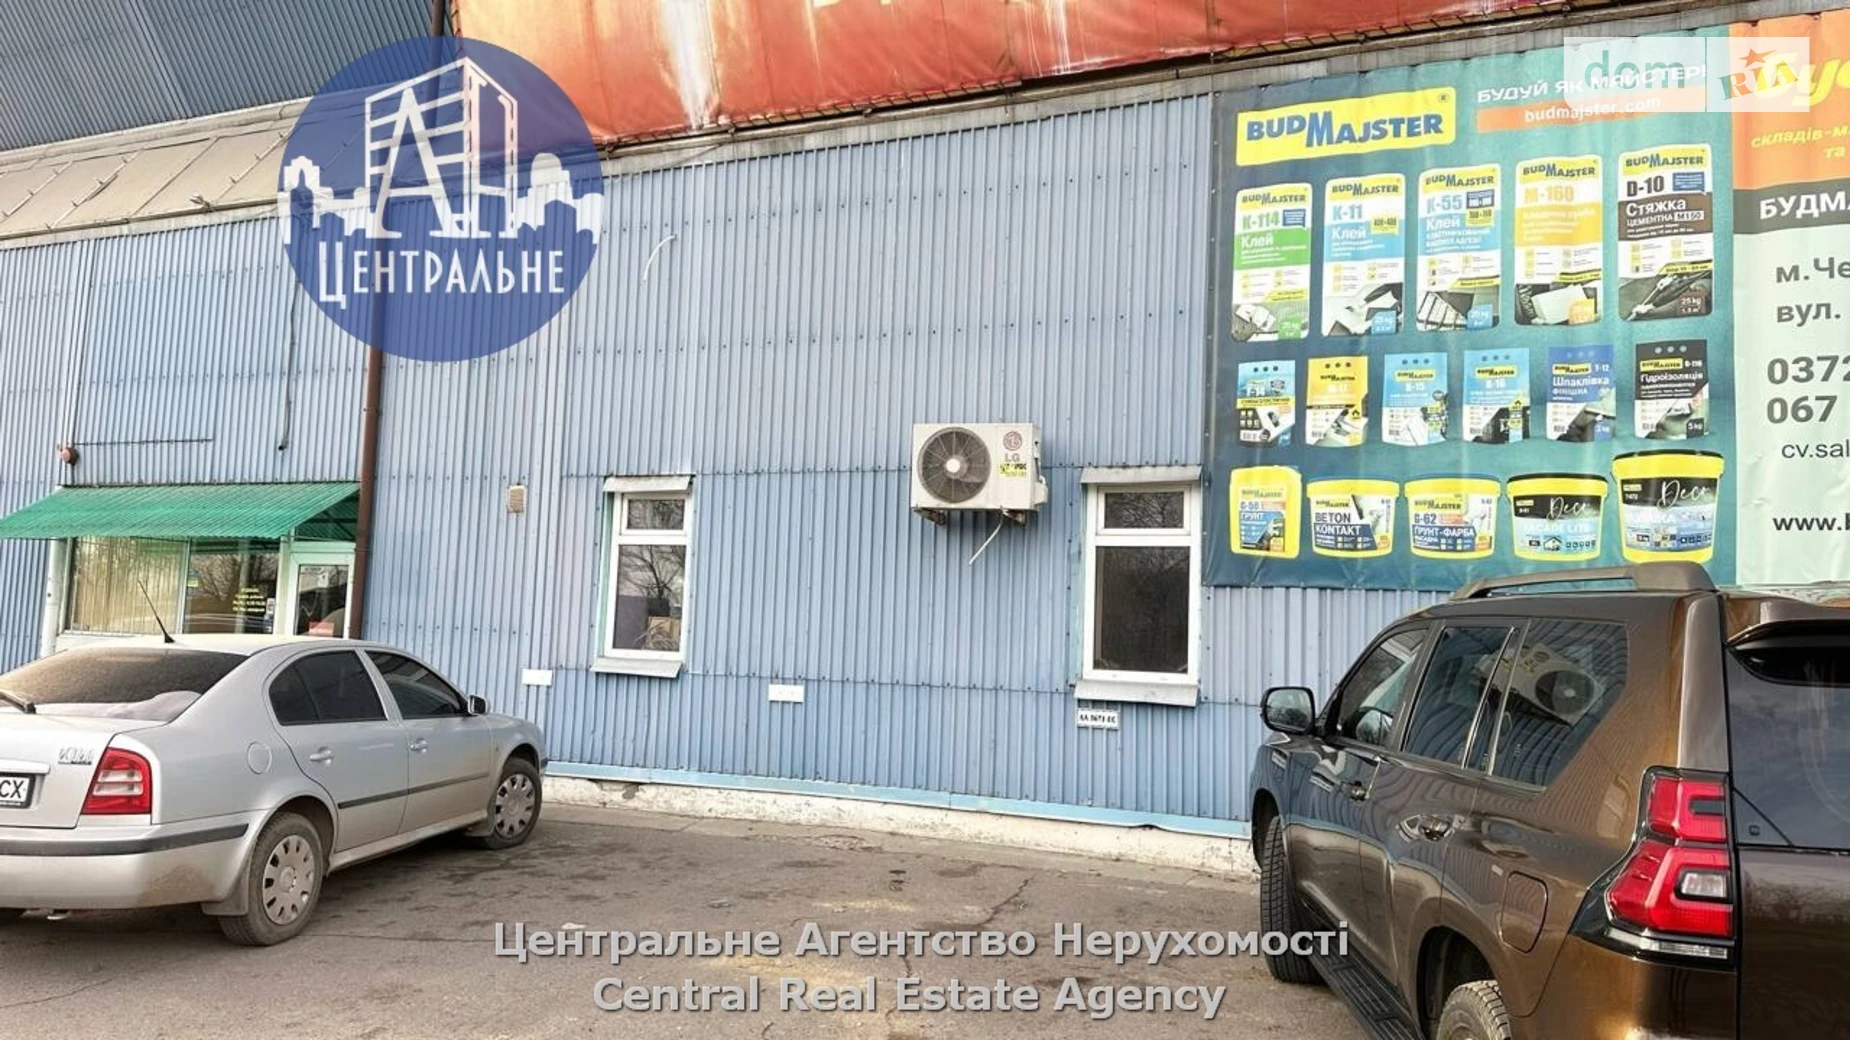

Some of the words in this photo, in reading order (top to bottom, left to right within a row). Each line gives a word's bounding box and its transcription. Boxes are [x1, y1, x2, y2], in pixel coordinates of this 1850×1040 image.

[1477, 79, 1549, 104] БУДУЙ
[1555, 79, 1584, 94] ЯК
[1525, 97, 1661, 123] budmajster.com
[1751, 124, 1850, 149] складів-м
[1824, 146, 1846, 158] та
[1627, 175, 1665, 197] D-10
[1626, 198, 1687, 217] Стяжка
[1759, 191, 1850, 220] БУДМ
[1426, 216, 1461, 232] Клей
[1627, 213, 1673, 228] ЦЕМЕНТНА
[1241, 232, 1275, 249] Клей
[1331, 226, 1367, 241] Клей
[1777, 302, 1841, 328] вул.
[1552, 376, 1610, 388] Шпаклівка
[1640, 371, 1704, 383] Гідроізоляція
[1766, 395, 1838, 424] 067
[1005, 453, 1020, 462] LG
[1315, 512, 1351, 523] BETON
[1315, 523, 1362, 536] KONTAKT
